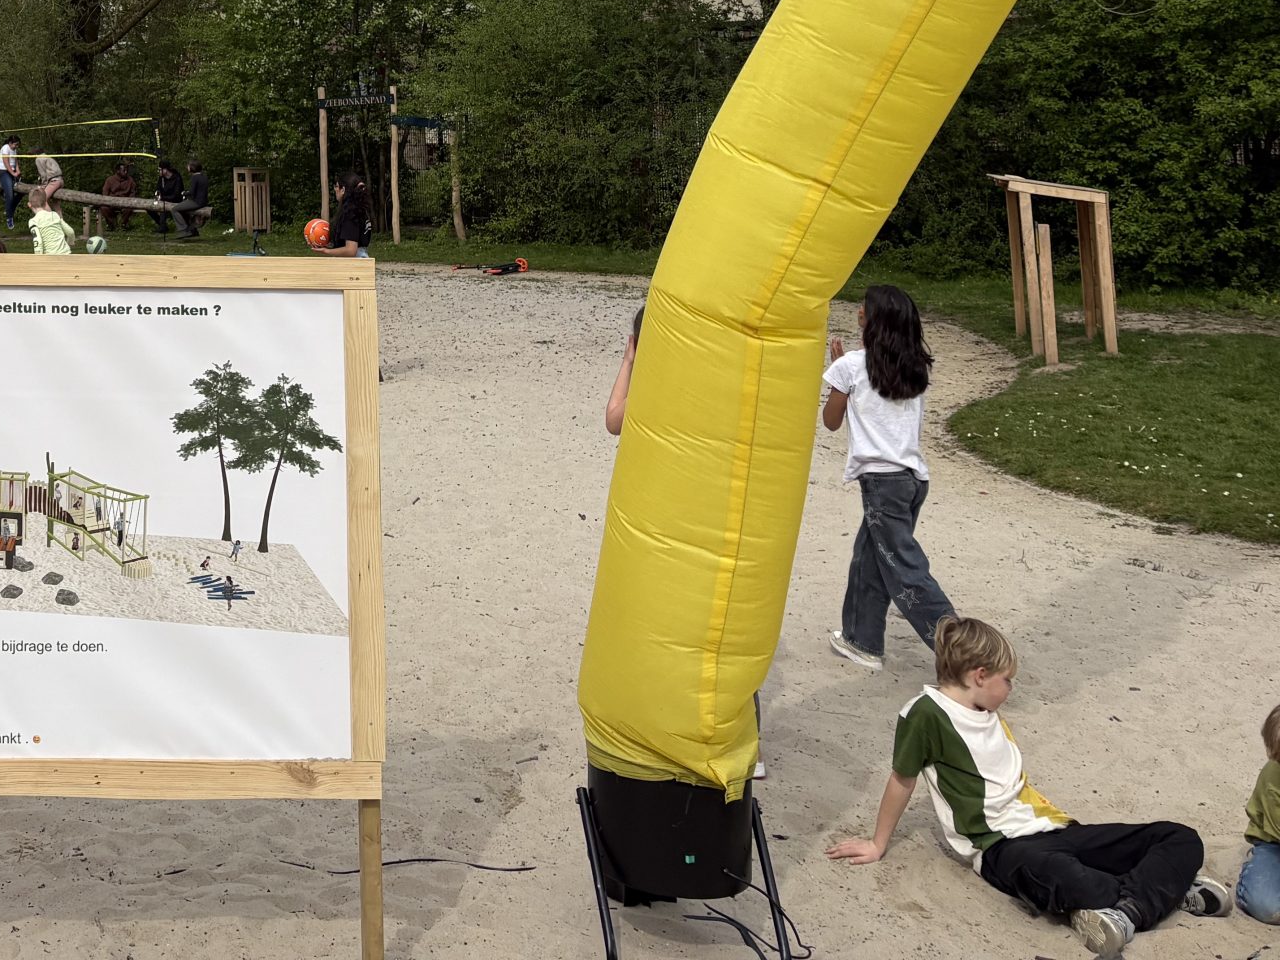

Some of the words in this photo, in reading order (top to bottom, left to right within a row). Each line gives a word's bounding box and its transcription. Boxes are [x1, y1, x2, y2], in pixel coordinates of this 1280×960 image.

[324, 95, 387, 108] ZEEBONKENPAD
[51, 304, 80, 318] nog
[83, 302, 133, 315] leuker
[136, 303, 153, 316] te
[157, 304, 209, 316] maken
[213, 304, 222, 316] ?
[1, 639, 53, 655] bijdrage
[56, 640, 69, 653] te
[72, 639, 108, 653] doen.
